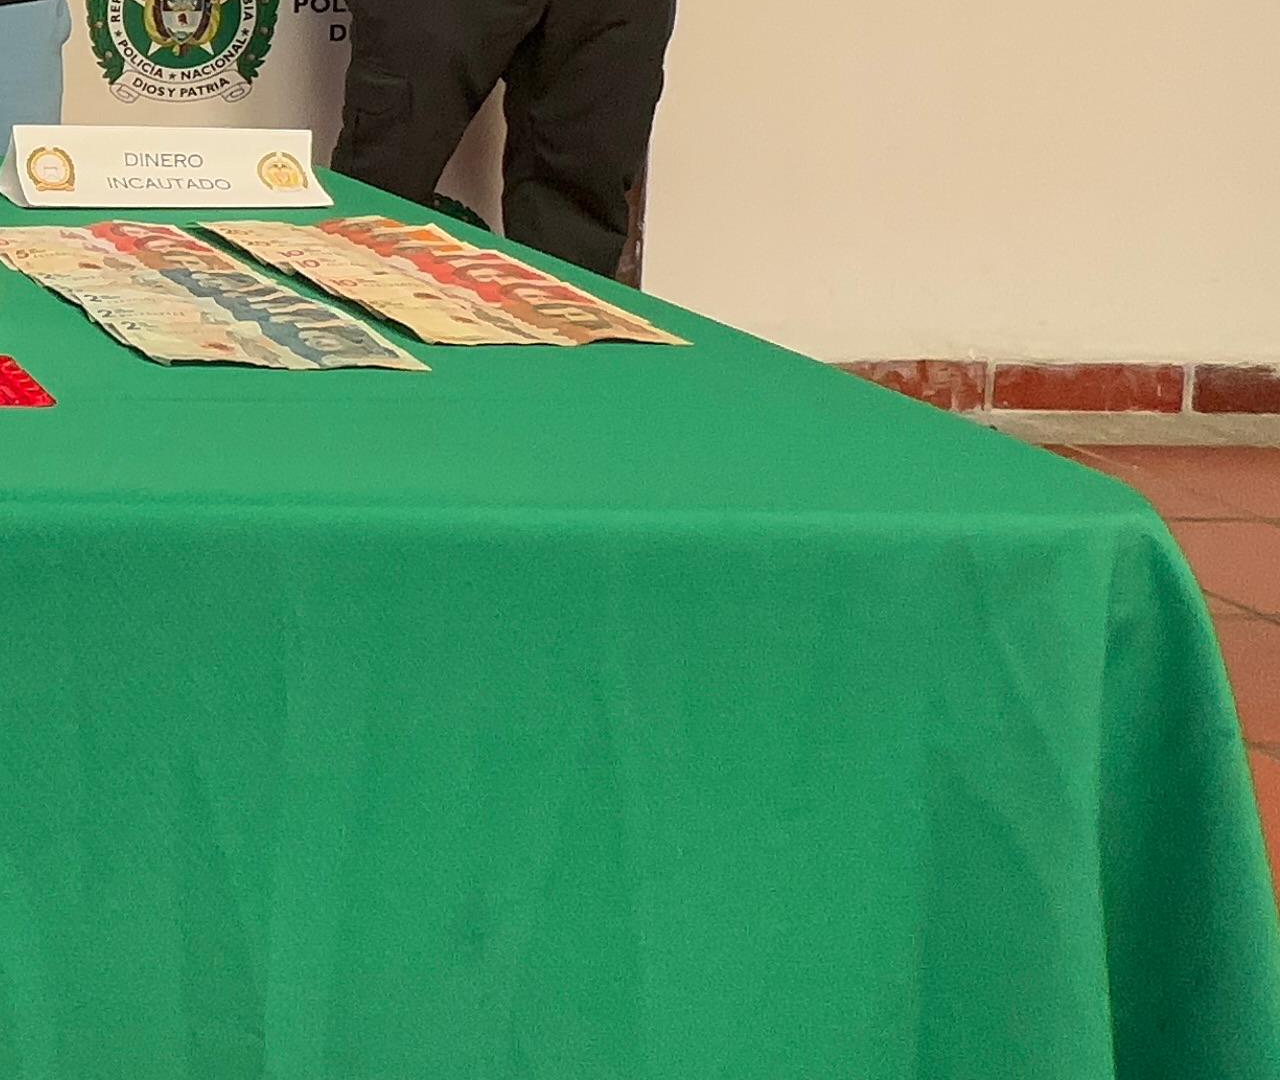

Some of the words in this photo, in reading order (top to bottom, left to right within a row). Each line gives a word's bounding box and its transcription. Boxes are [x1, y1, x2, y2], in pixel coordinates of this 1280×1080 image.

[181, 36, 247, 80] NACIONAL
[133, 78, 163, 96] DIOS
[180, 78, 230, 97] PATRIA
[124, 152, 203, 168] DINERO
[107, 177, 231, 191] INCAUTADO
